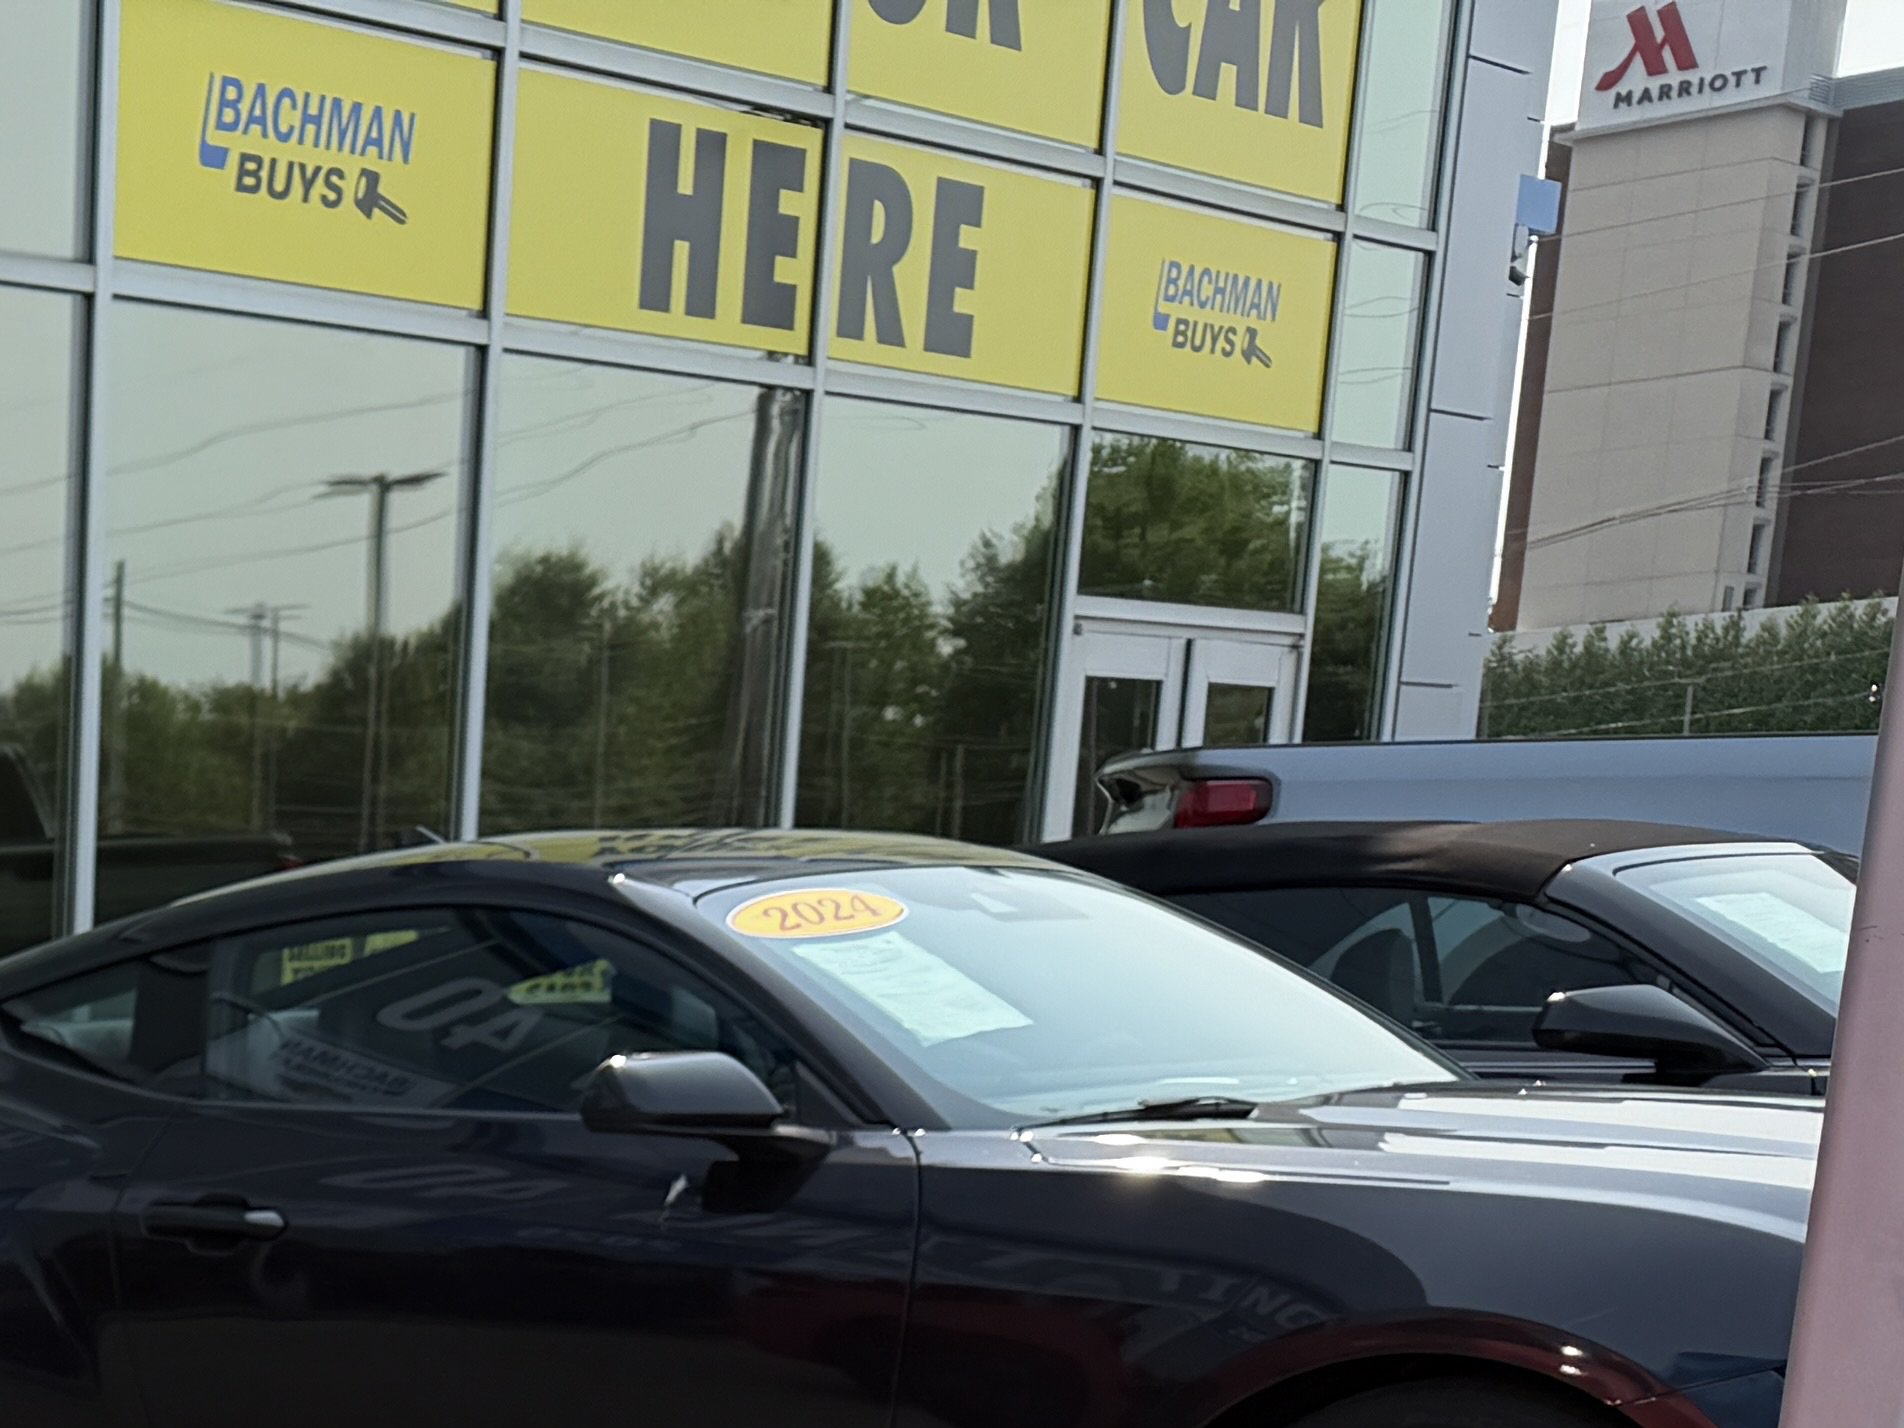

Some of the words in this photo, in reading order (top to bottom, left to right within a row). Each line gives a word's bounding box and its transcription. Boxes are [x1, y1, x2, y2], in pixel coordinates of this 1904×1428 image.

[1140, 0, 1324, 129] CAR
[1612, 65, 1768, 109] MARRIOTT
[214, 74, 416, 165] BACHMAN
[234, 151, 347, 209] BUYS
[638, 117, 985, 359] HERE
[1162, 259, 1282, 322] BACHMAN
[1171, 317, 1238, 358] BUYS
[762, 894, 882, 932] 2024
